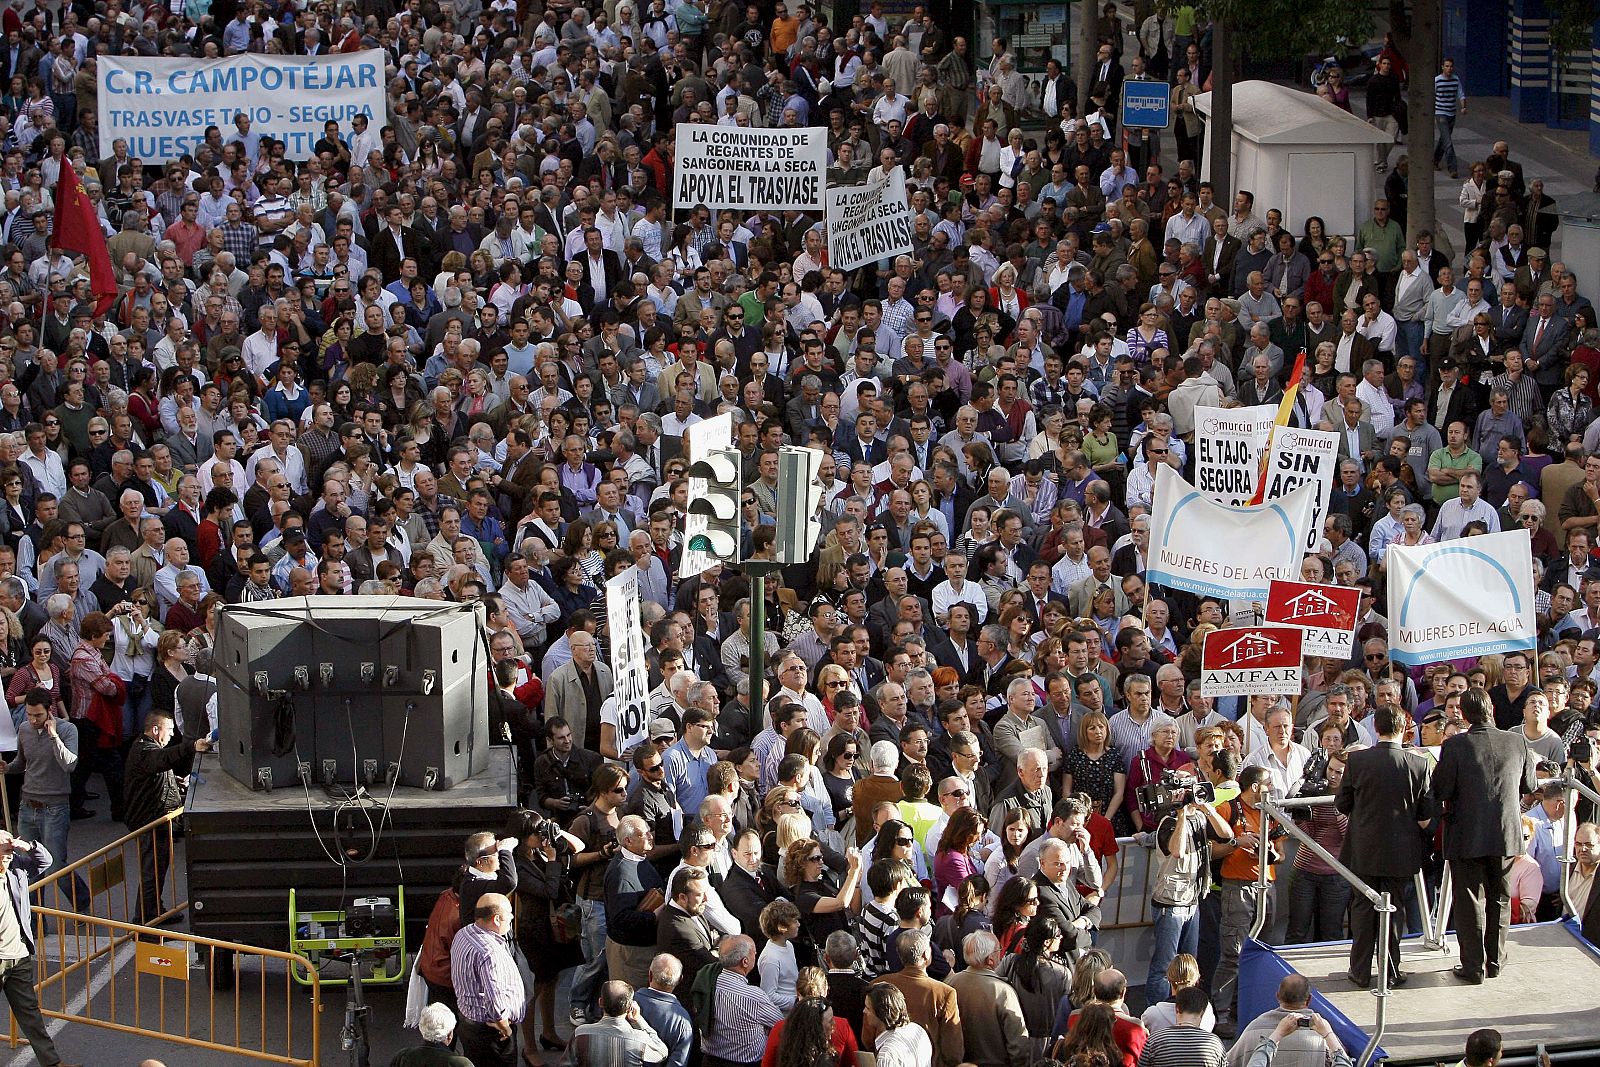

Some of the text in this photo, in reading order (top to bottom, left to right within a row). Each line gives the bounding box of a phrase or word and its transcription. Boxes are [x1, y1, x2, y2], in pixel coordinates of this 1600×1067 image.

[105, 62, 377, 94] C.R. CAMPOTÉJAR
[110, 109, 216, 127] TRASVASE
[290, 104, 374, 123] SEGURA
[126, 136, 224, 158] NUEST
[692, 131, 809, 147] LA COMUNIDAD DE
[706, 145, 794, 159] REGANTES DE
[682, 157, 817, 172] SANGONERA LA SECA
[679, 174, 818, 204] APOYA EL TRASVASE
[836, 194, 847, 206] LA
[867, 208, 877, 221] LA
[878, 200, 906, 217] SECA
[850, 232, 862, 262] EL
[1219, 421, 1252, 433] murcia
[1256, 418, 1274, 430] rcia
[1200, 438, 1214, 463] EL
[1216, 440, 1252, 465] TAJO-
[1297, 437, 1333, 449] murcia
[1278, 452, 1320, 474] SIN
[1200, 467, 1252, 494] SEGURA
[1160, 549, 1219, 575] MUJERES
[1223, 565, 1249, 580] DEL
[1171, 578, 1267, 600] www.mujeresdelagua.co
[1304, 629, 1350, 645] FAR
[1400, 617, 1523, 644] MUJERES DEL AGUA
[1419, 643, 1507, 661] www.mujeresdelagua.com
[1204, 669, 1299, 684] AMFAR
